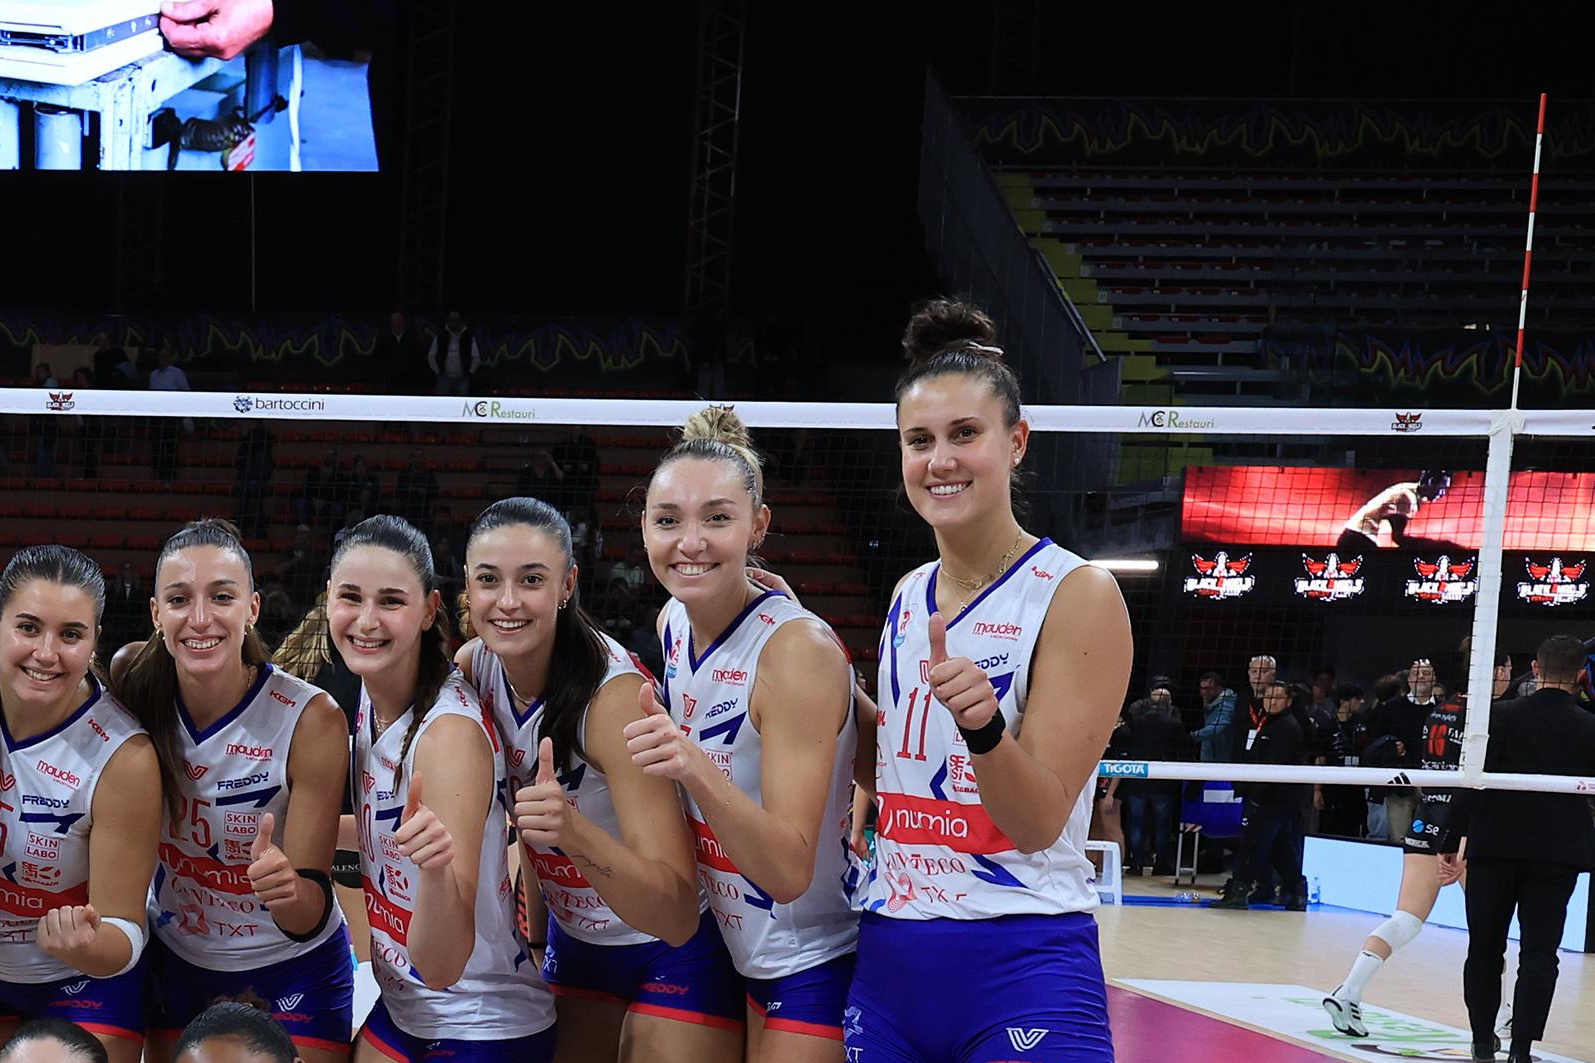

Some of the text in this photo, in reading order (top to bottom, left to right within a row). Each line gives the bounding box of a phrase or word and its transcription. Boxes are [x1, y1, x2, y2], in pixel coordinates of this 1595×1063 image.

[255, 397, 325, 412] bartoccini
[490, 401, 535, 419] Restauri
[1167, 411, 1214, 429] Restauri
[973, 621, 1022, 636] mauden
[269, 690, 296, 708] KGM
[88, 718, 111, 743] KGM
[896, 688, 932, 761] 11
[36, 759, 81, 787] mauden
[217, 771, 270, 790] FREDDY
[22, 794, 70, 809] FREDDY
[226, 813, 256, 823] SKIN
[896, 809, 969, 838] numia
[226, 824, 256, 834] LABO
[28, 834, 58, 848] SKIN
[26, 846, 57, 859] LABO
[700, 870, 739, 900] TECO
[213, 920, 259, 936] TXT
